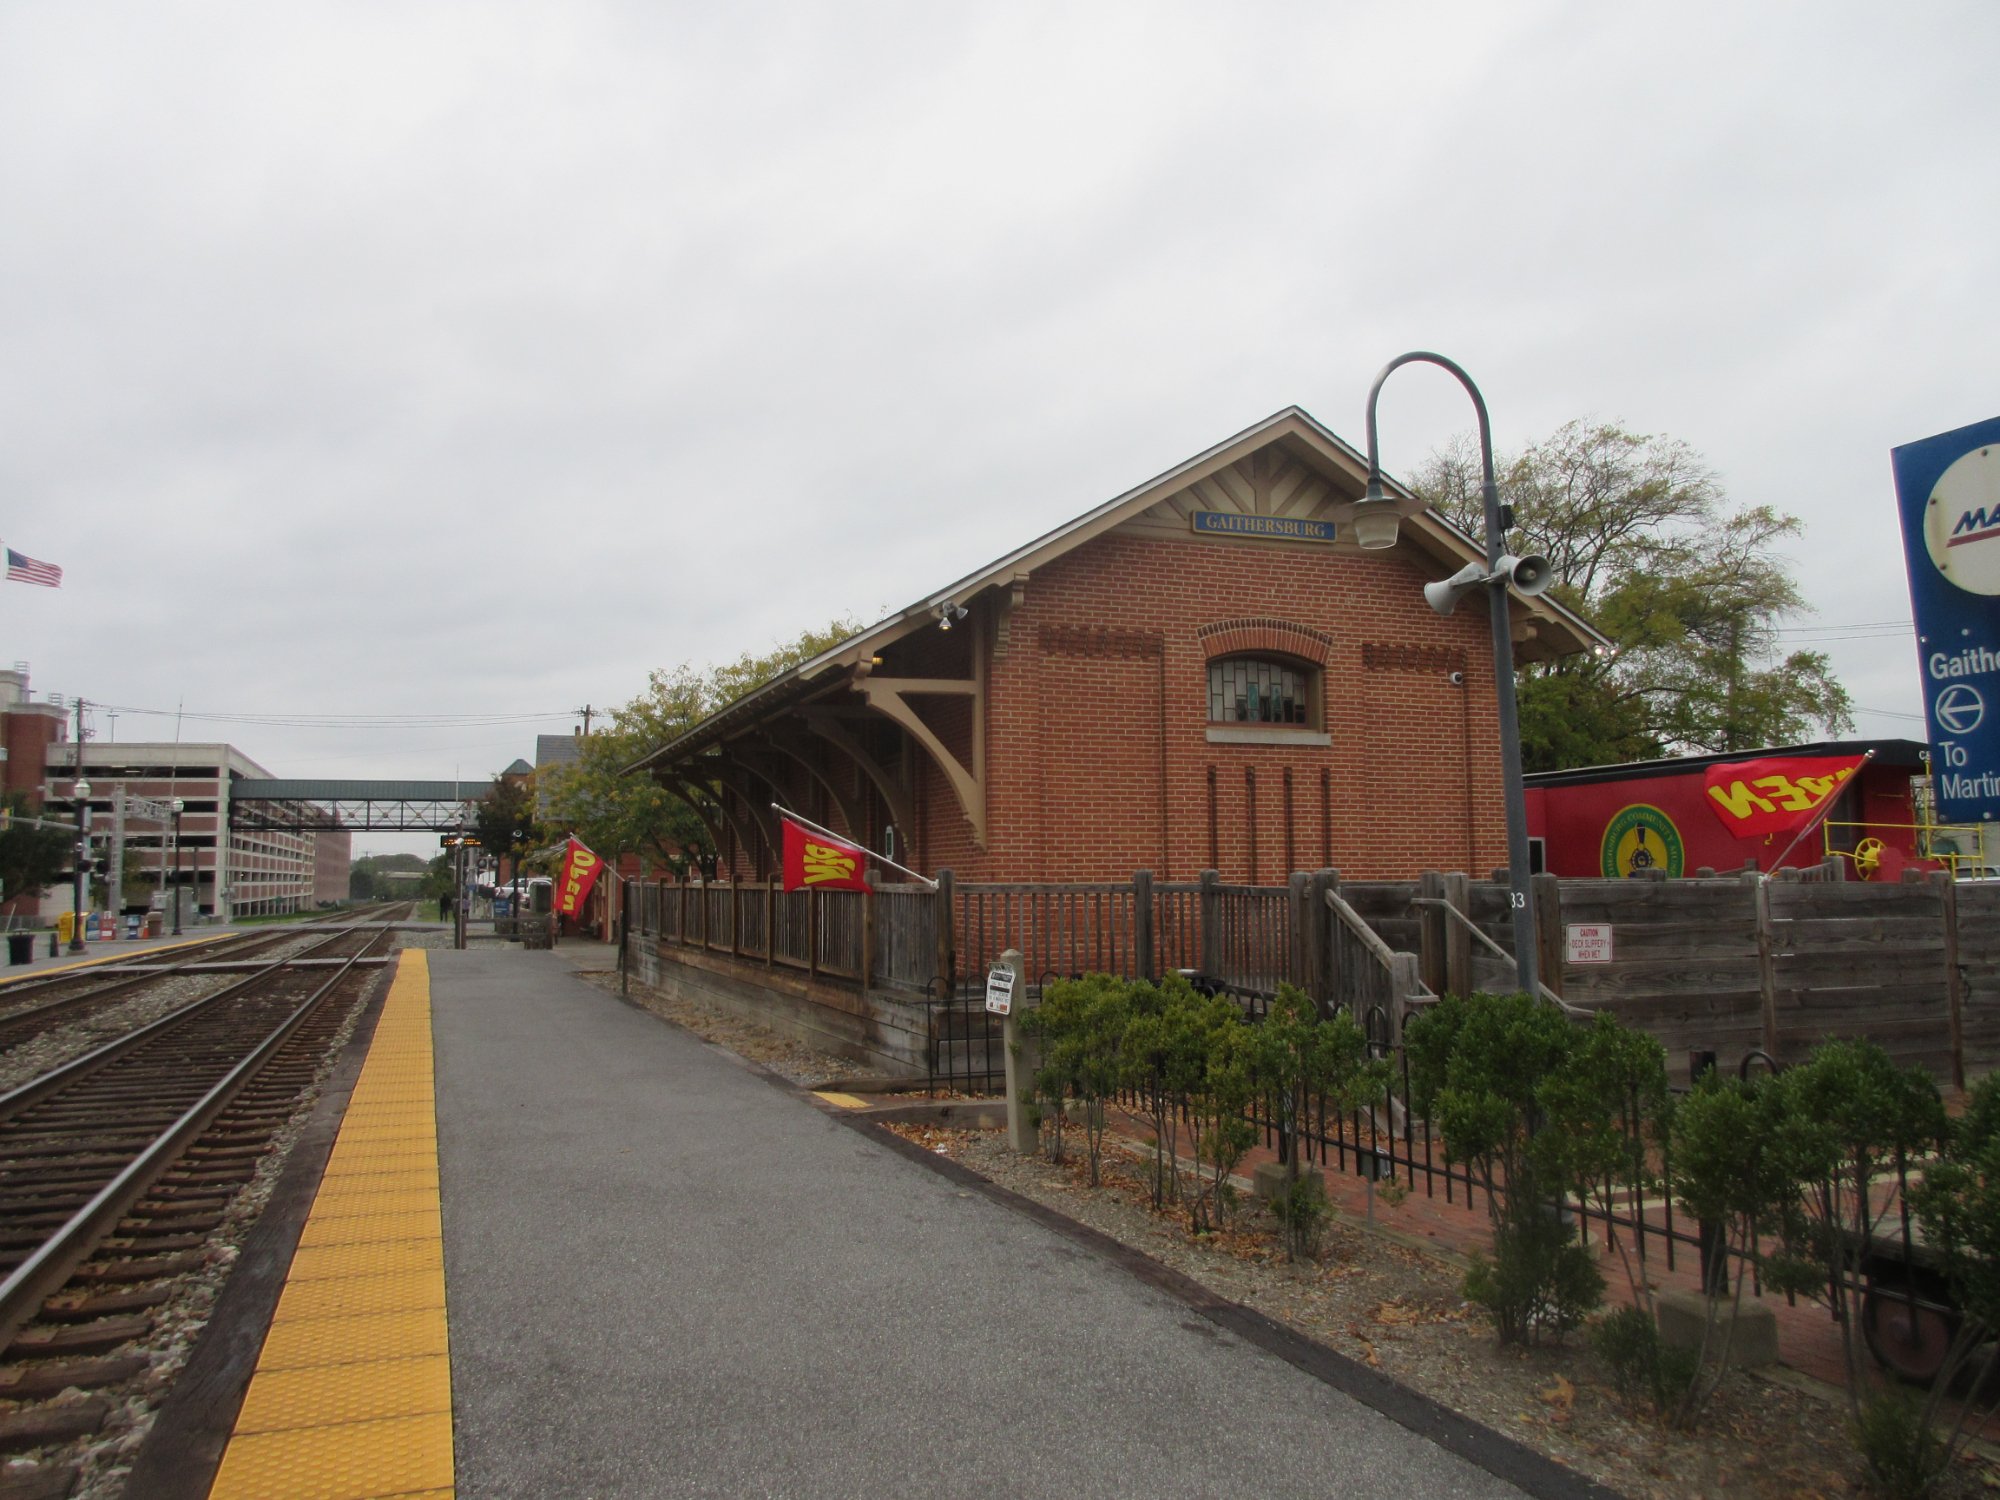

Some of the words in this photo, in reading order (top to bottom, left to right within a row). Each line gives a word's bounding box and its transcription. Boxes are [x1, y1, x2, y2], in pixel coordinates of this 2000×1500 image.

[1206, 514, 1325, 537] GAITHERSBURG
[1938, 741, 1967, 766] To
[1579, 928, 1598, 937] CAUTION
[1571, 939, 1583, 949] DECK
[1584, 939, 1606, 949] SLIPPERY
